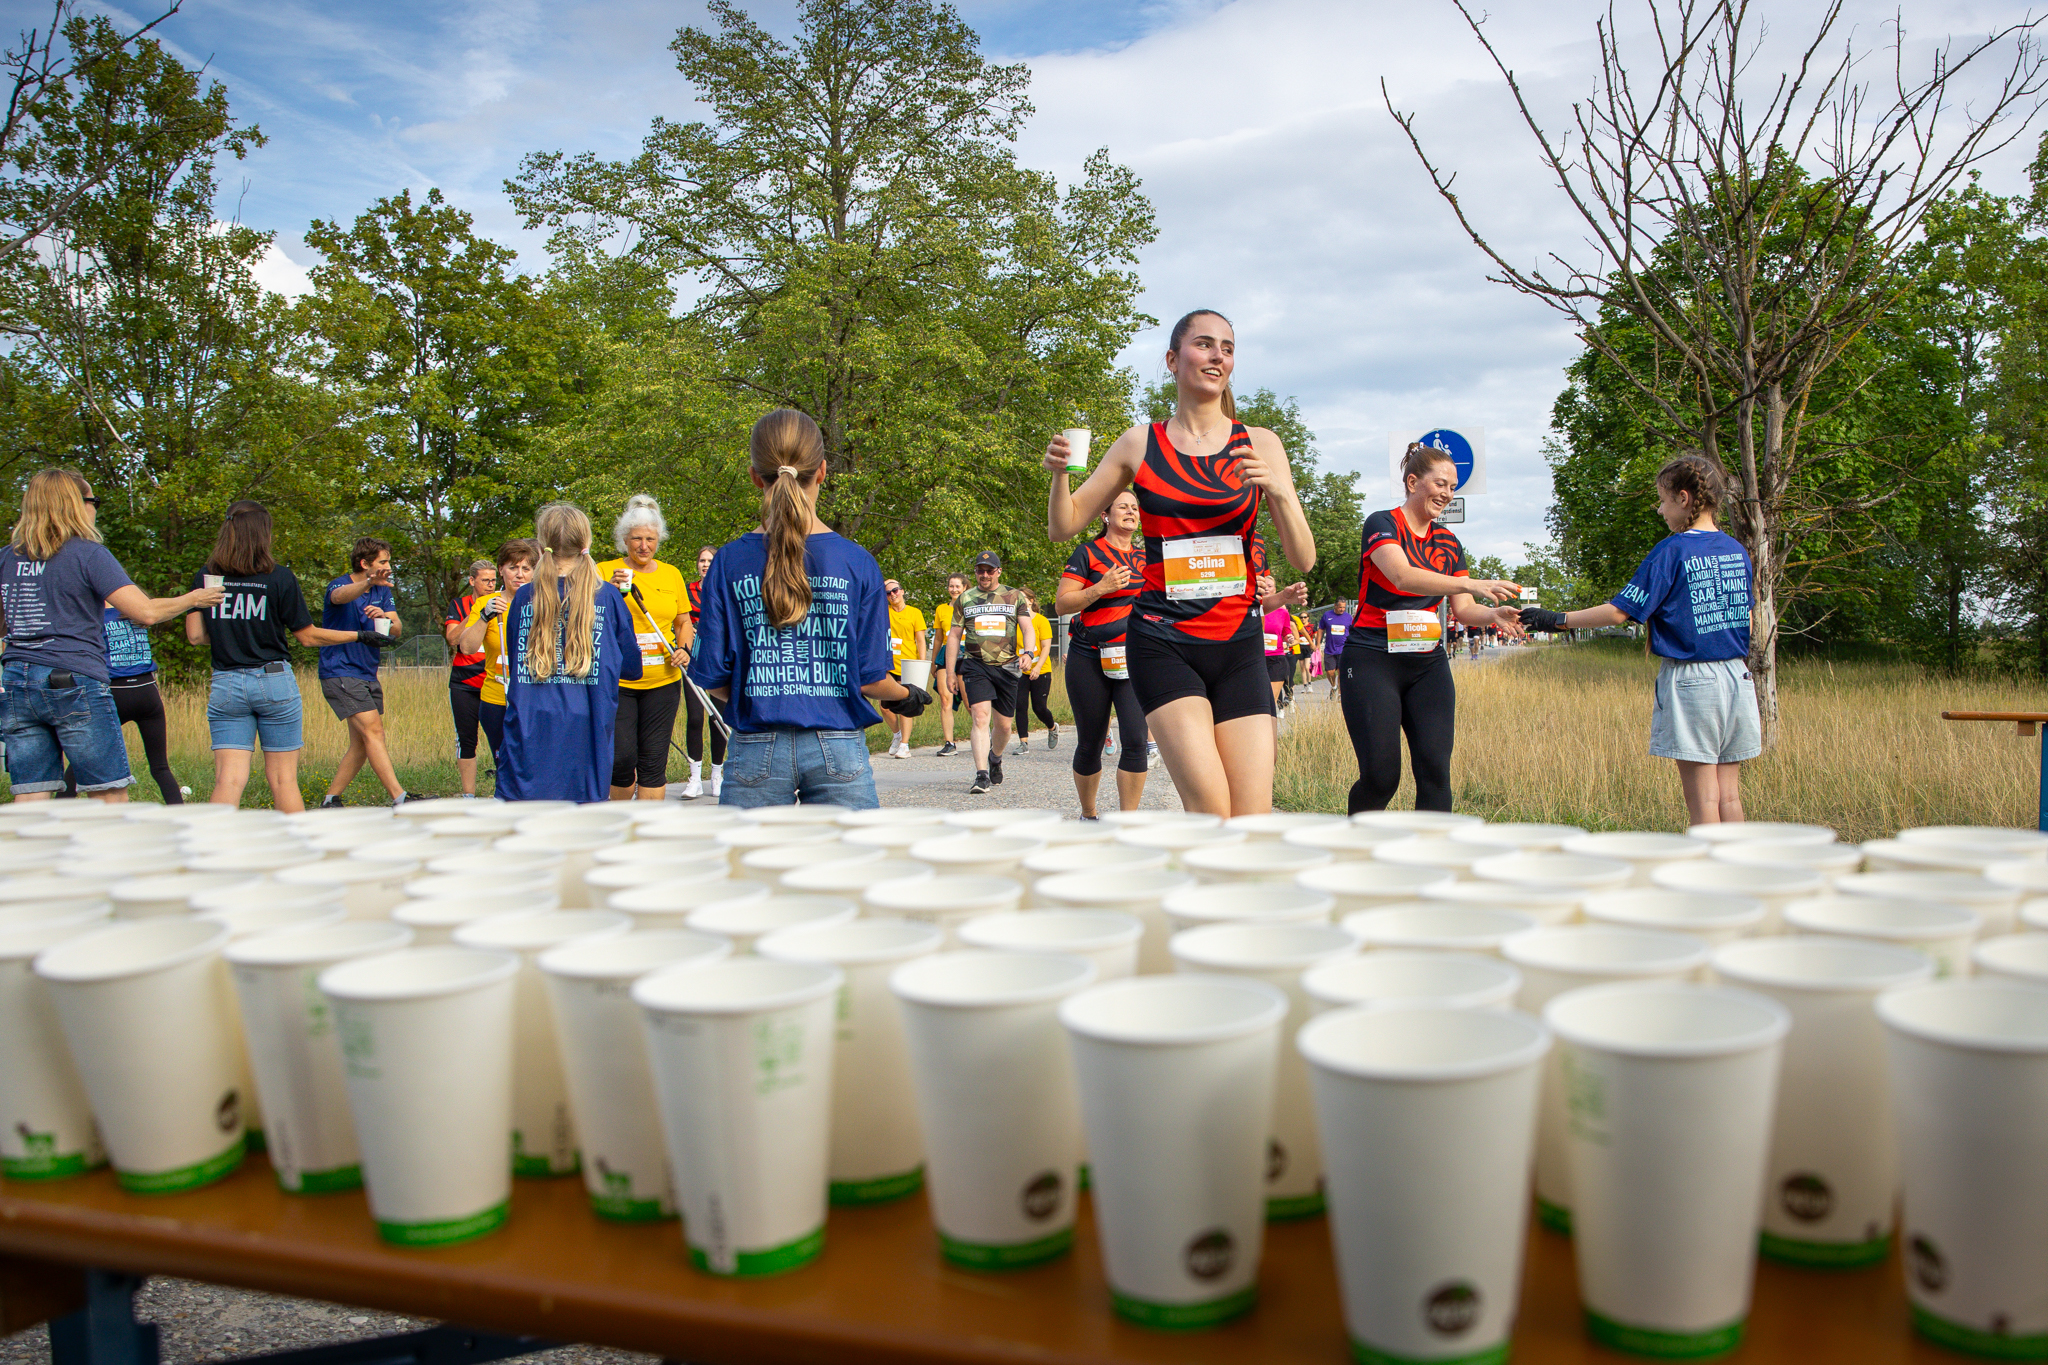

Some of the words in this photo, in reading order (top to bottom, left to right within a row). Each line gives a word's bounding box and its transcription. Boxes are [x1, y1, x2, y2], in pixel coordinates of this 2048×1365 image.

[16, 561, 46, 576] TEAM
[1188, 557, 1225, 569] Selina
[1684, 556, 1712, 573] KÖLN
[1687, 569, 1714, 583] LANDAU
[733, 574, 762, 601] KÖL
[808, 576, 849, 590] GOLSTADT
[1722, 578, 1748, 592] MAINZ
[812, 591, 849, 602] RICHSHAFEN
[1620, 583, 1649, 607] TEAM
[1690, 587, 1716, 604] SAAR
[739, 596, 765, 616] LAND
[808, 603, 849, 616] ARLOUIS
[965, 605, 1014, 615] SPORTKAMERAD
[1729, 605, 1750, 620] BURG
[105, 620, 125, 631] KÖLN
[797, 617, 847, 638] MAINZ
[1403, 623, 1428, 632] Nicola
[109, 640, 130, 650] SAAR
[782, 641, 795, 663] BAD
[796, 640, 809, 664] LAHR
[813, 640, 847, 660] LUXEM
[110, 653, 142, 662] MANNHEIM
[813, 661, 847, 686] BURG
